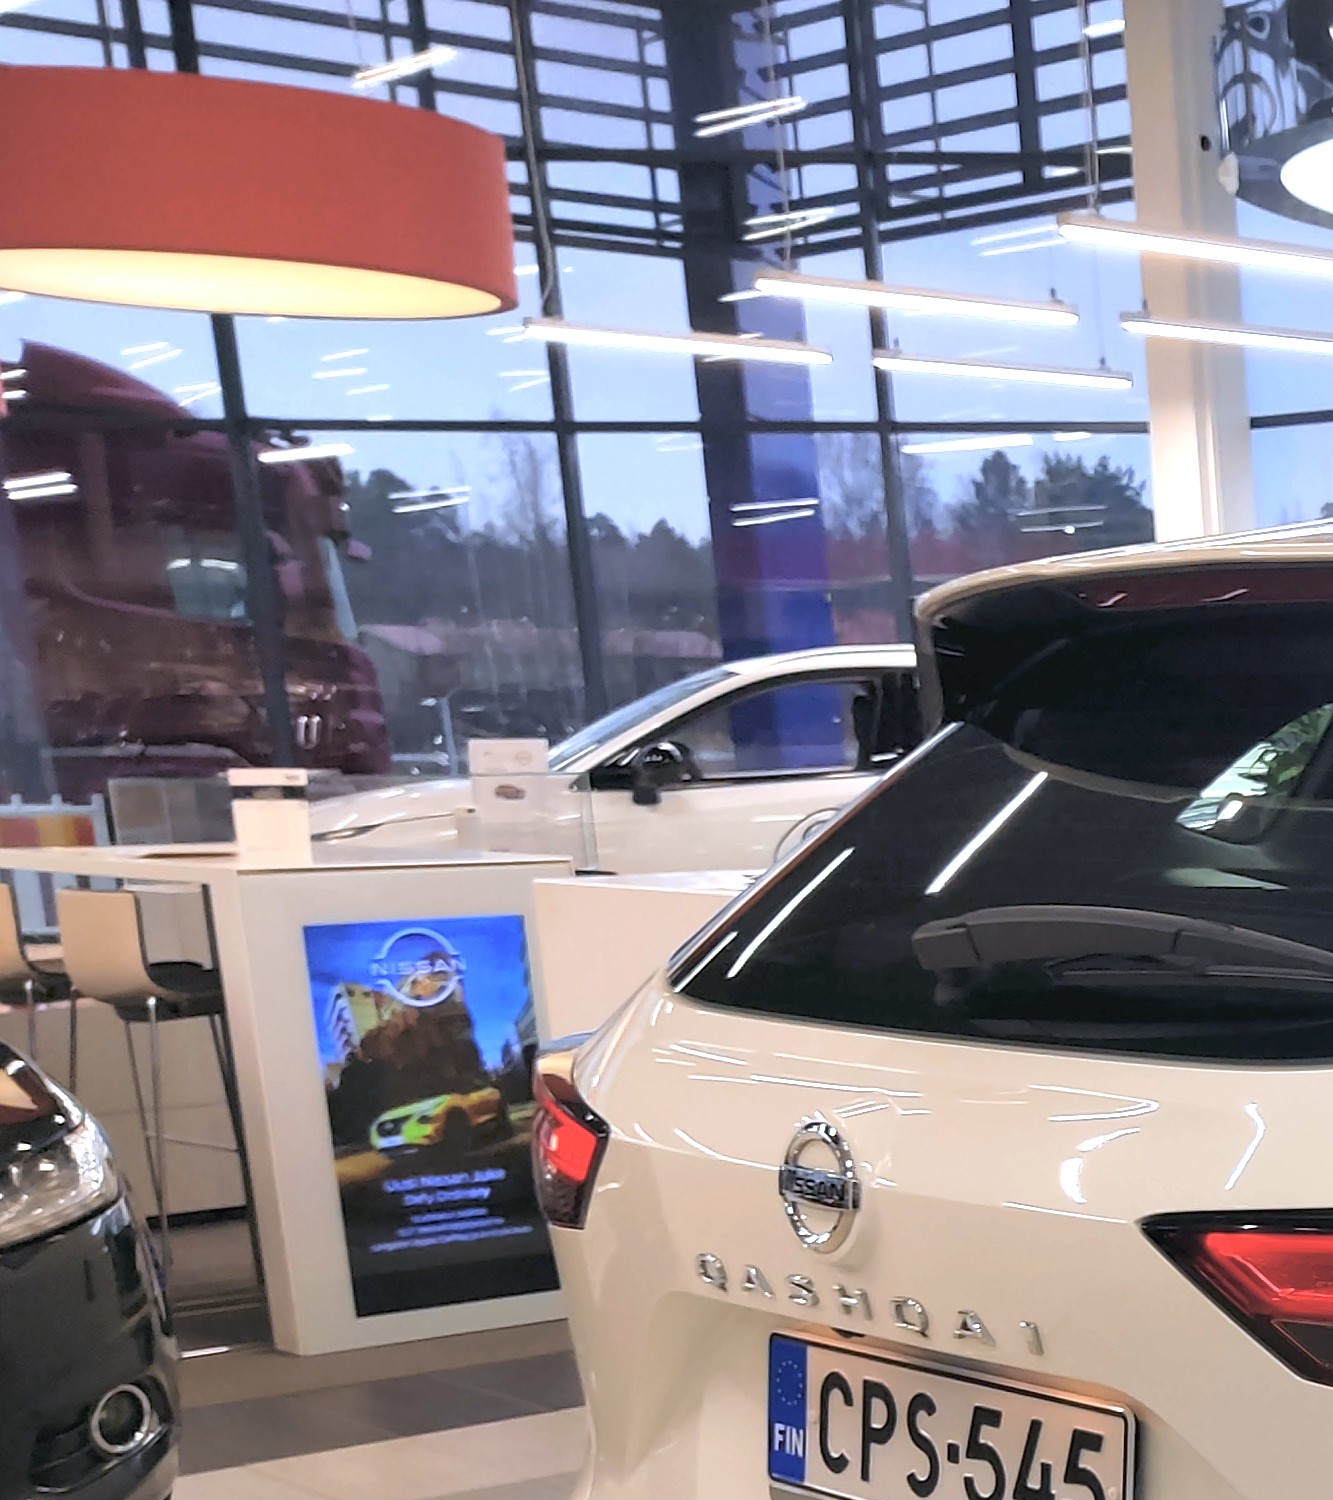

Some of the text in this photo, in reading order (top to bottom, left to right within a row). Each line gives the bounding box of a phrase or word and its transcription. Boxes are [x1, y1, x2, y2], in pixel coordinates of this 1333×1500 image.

[369, 958, 467, 976] NISSAN
[695, 1252, 1045, 1357] QASHQAI
[773, 1422, 804, 1459] FIN
